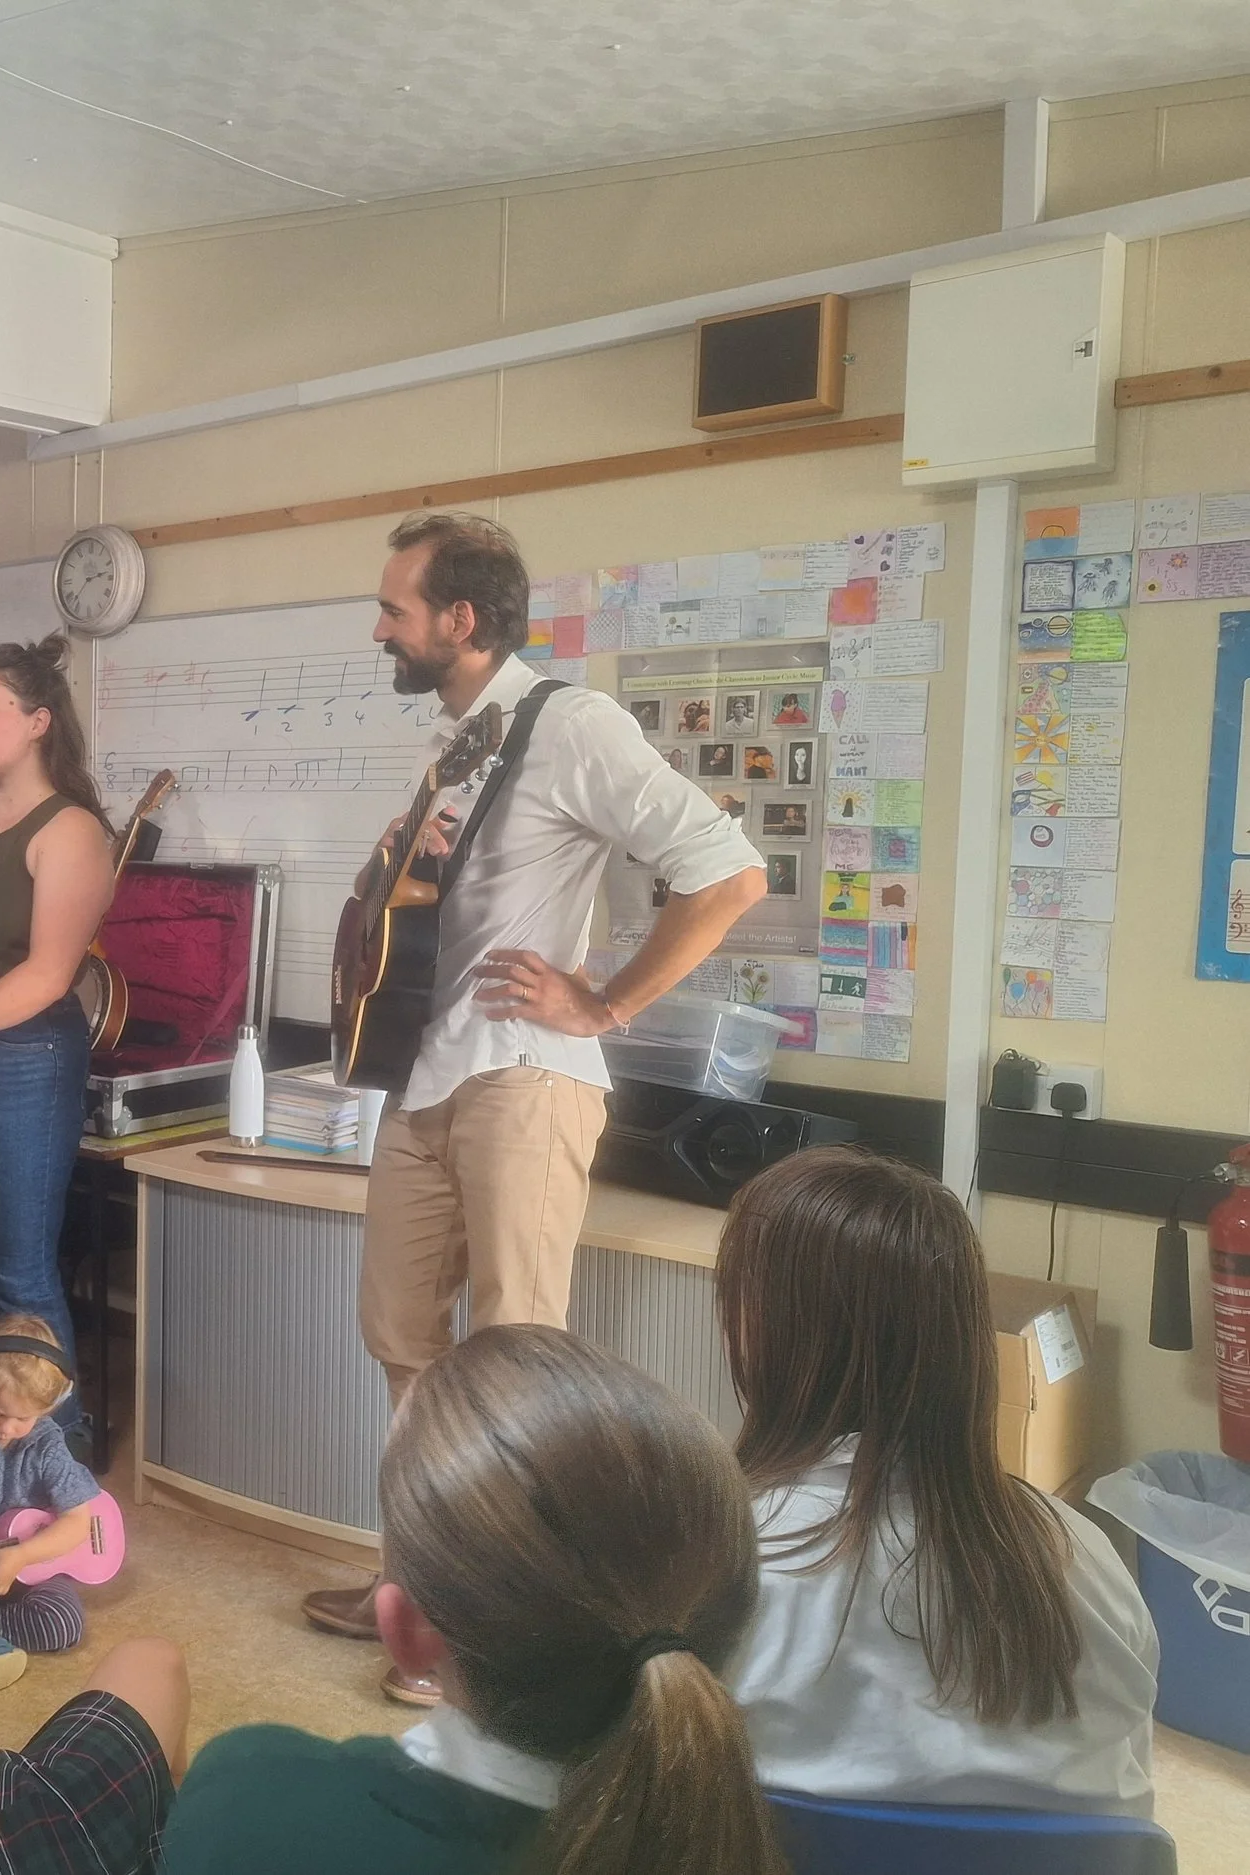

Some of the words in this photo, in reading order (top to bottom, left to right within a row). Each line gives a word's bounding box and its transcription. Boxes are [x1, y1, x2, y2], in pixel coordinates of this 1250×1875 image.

[281, 721, 294, 733] 2
[323, 711, 334, 727] 3
[353, 711, 366, 725] 4
[838, 734, 870, 746] CALL
[103, 751, 117, 771] 6
[105, 774, 117, 790] 8
[748, 932, 762, 942] the
[764, 933, 797, 944] Artists!
